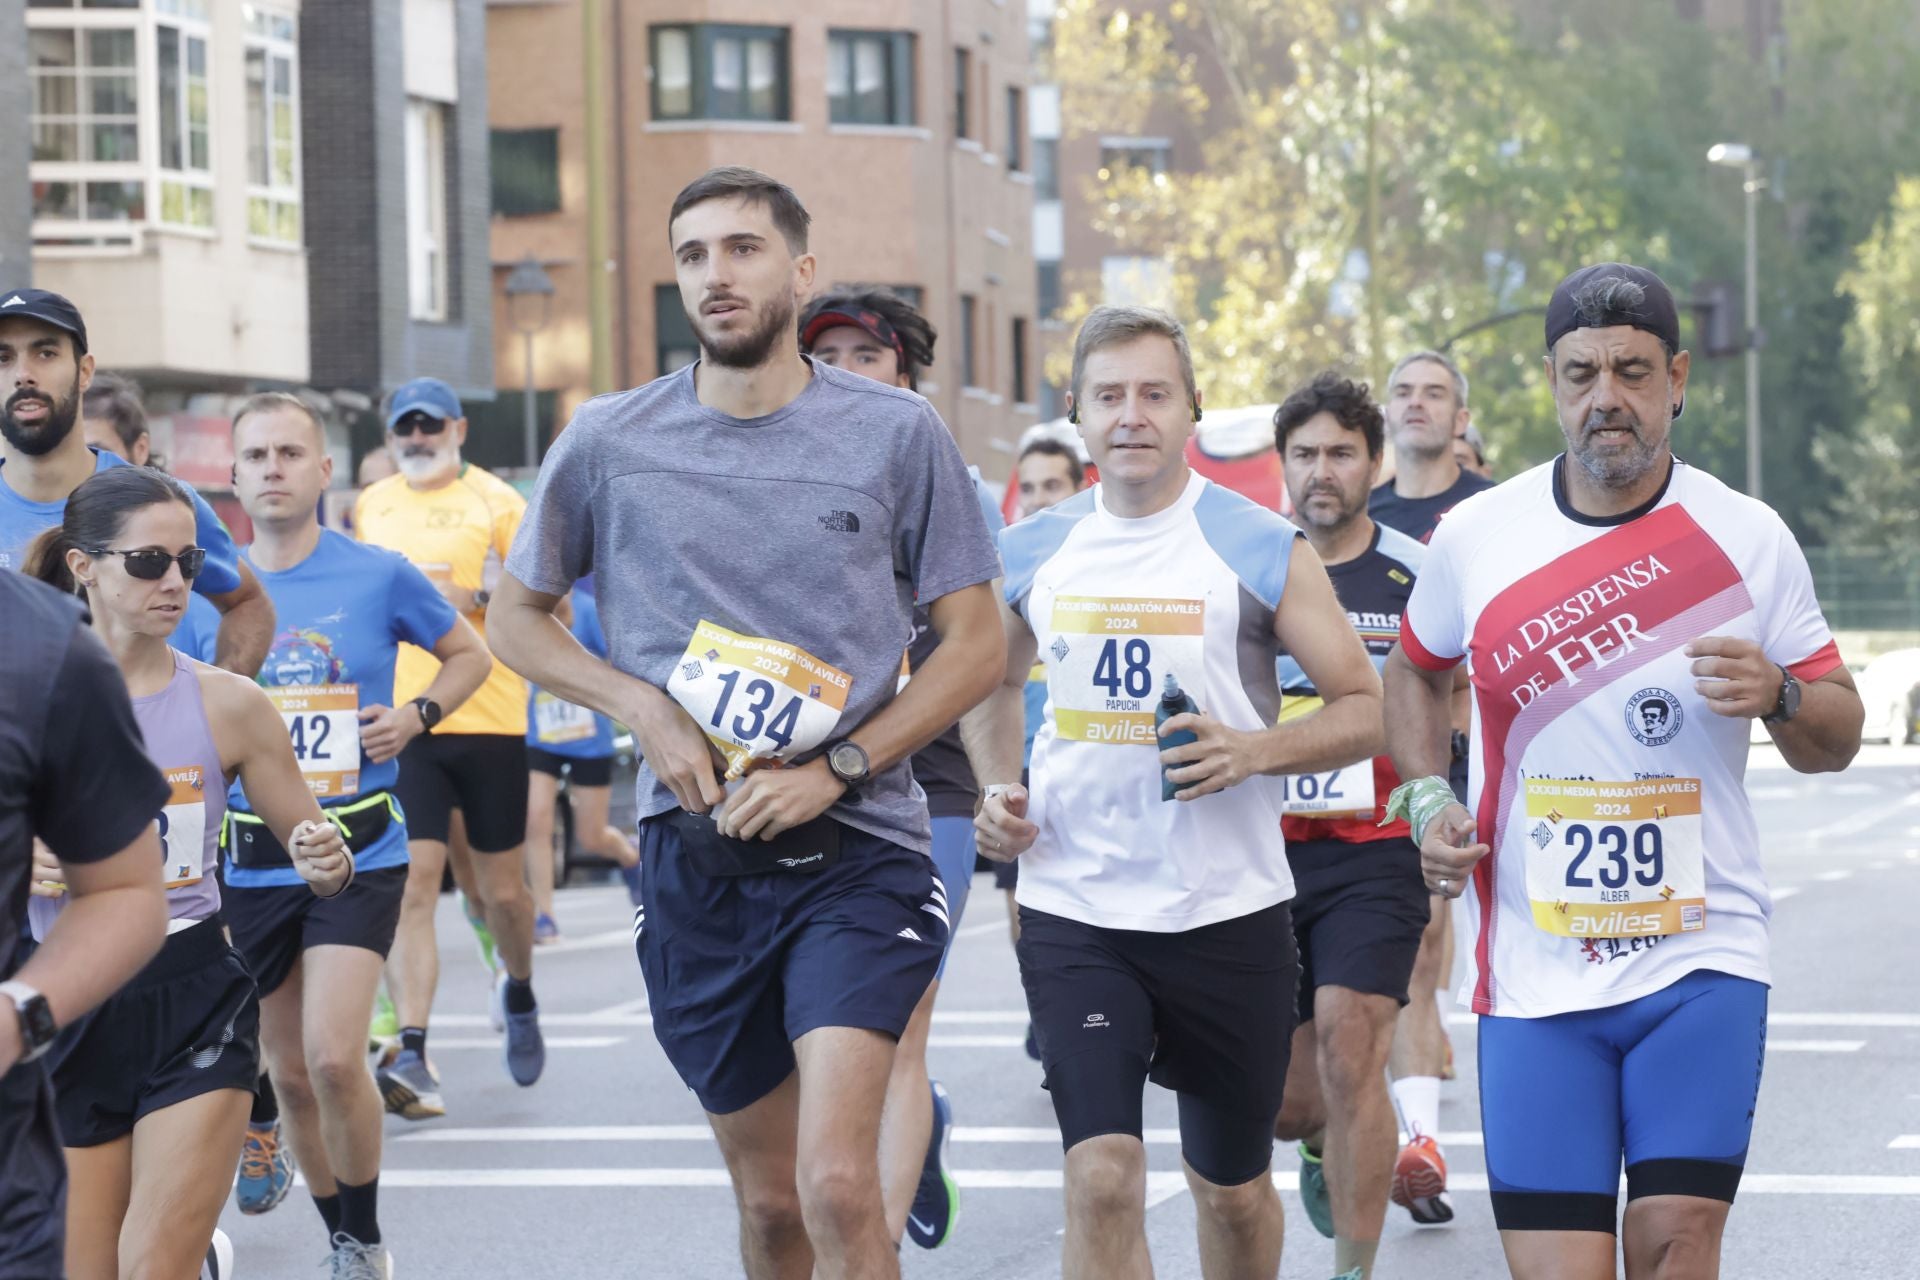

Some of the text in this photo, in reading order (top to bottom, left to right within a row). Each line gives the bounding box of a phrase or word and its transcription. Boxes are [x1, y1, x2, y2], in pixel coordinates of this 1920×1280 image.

[818, 515, 847, 523] NORTH
[825, 524, 846, 532] FACE
[1110, 601, 1164, 613] MARATÓN
[1164, 602, 1201, 614] AVILÉS
[1493, 554, 1671, 674] LA DESPENSA
[1104, 618, 1138, 629] 2024
[752, 656, 790, 677] 2024
[765, 644, 814, 672] MARATÓN
[815, 667, 847, 688] AVILÉS
[1092, 638, 1152, 698] 48
[1511, 613, 1660, 711] DE FER
[711, 670, 804, 752] 134
[1106, 700, 1140, 711] PAPUCHI
[1086, 719, 1157, 740] avilés
[1563, 786, 1597, 797] MEDIA
[1600, 782, 1656, 798] MARATÓN
[1658, 781, 1697, 793] AVILÉS
[1593, 804, 1631, 815] 2024
[1565, 823, 1663, 889] 239
[1600, 891, 1630, 902] ALBER
[1570, 912, 1662, 934] avilés
